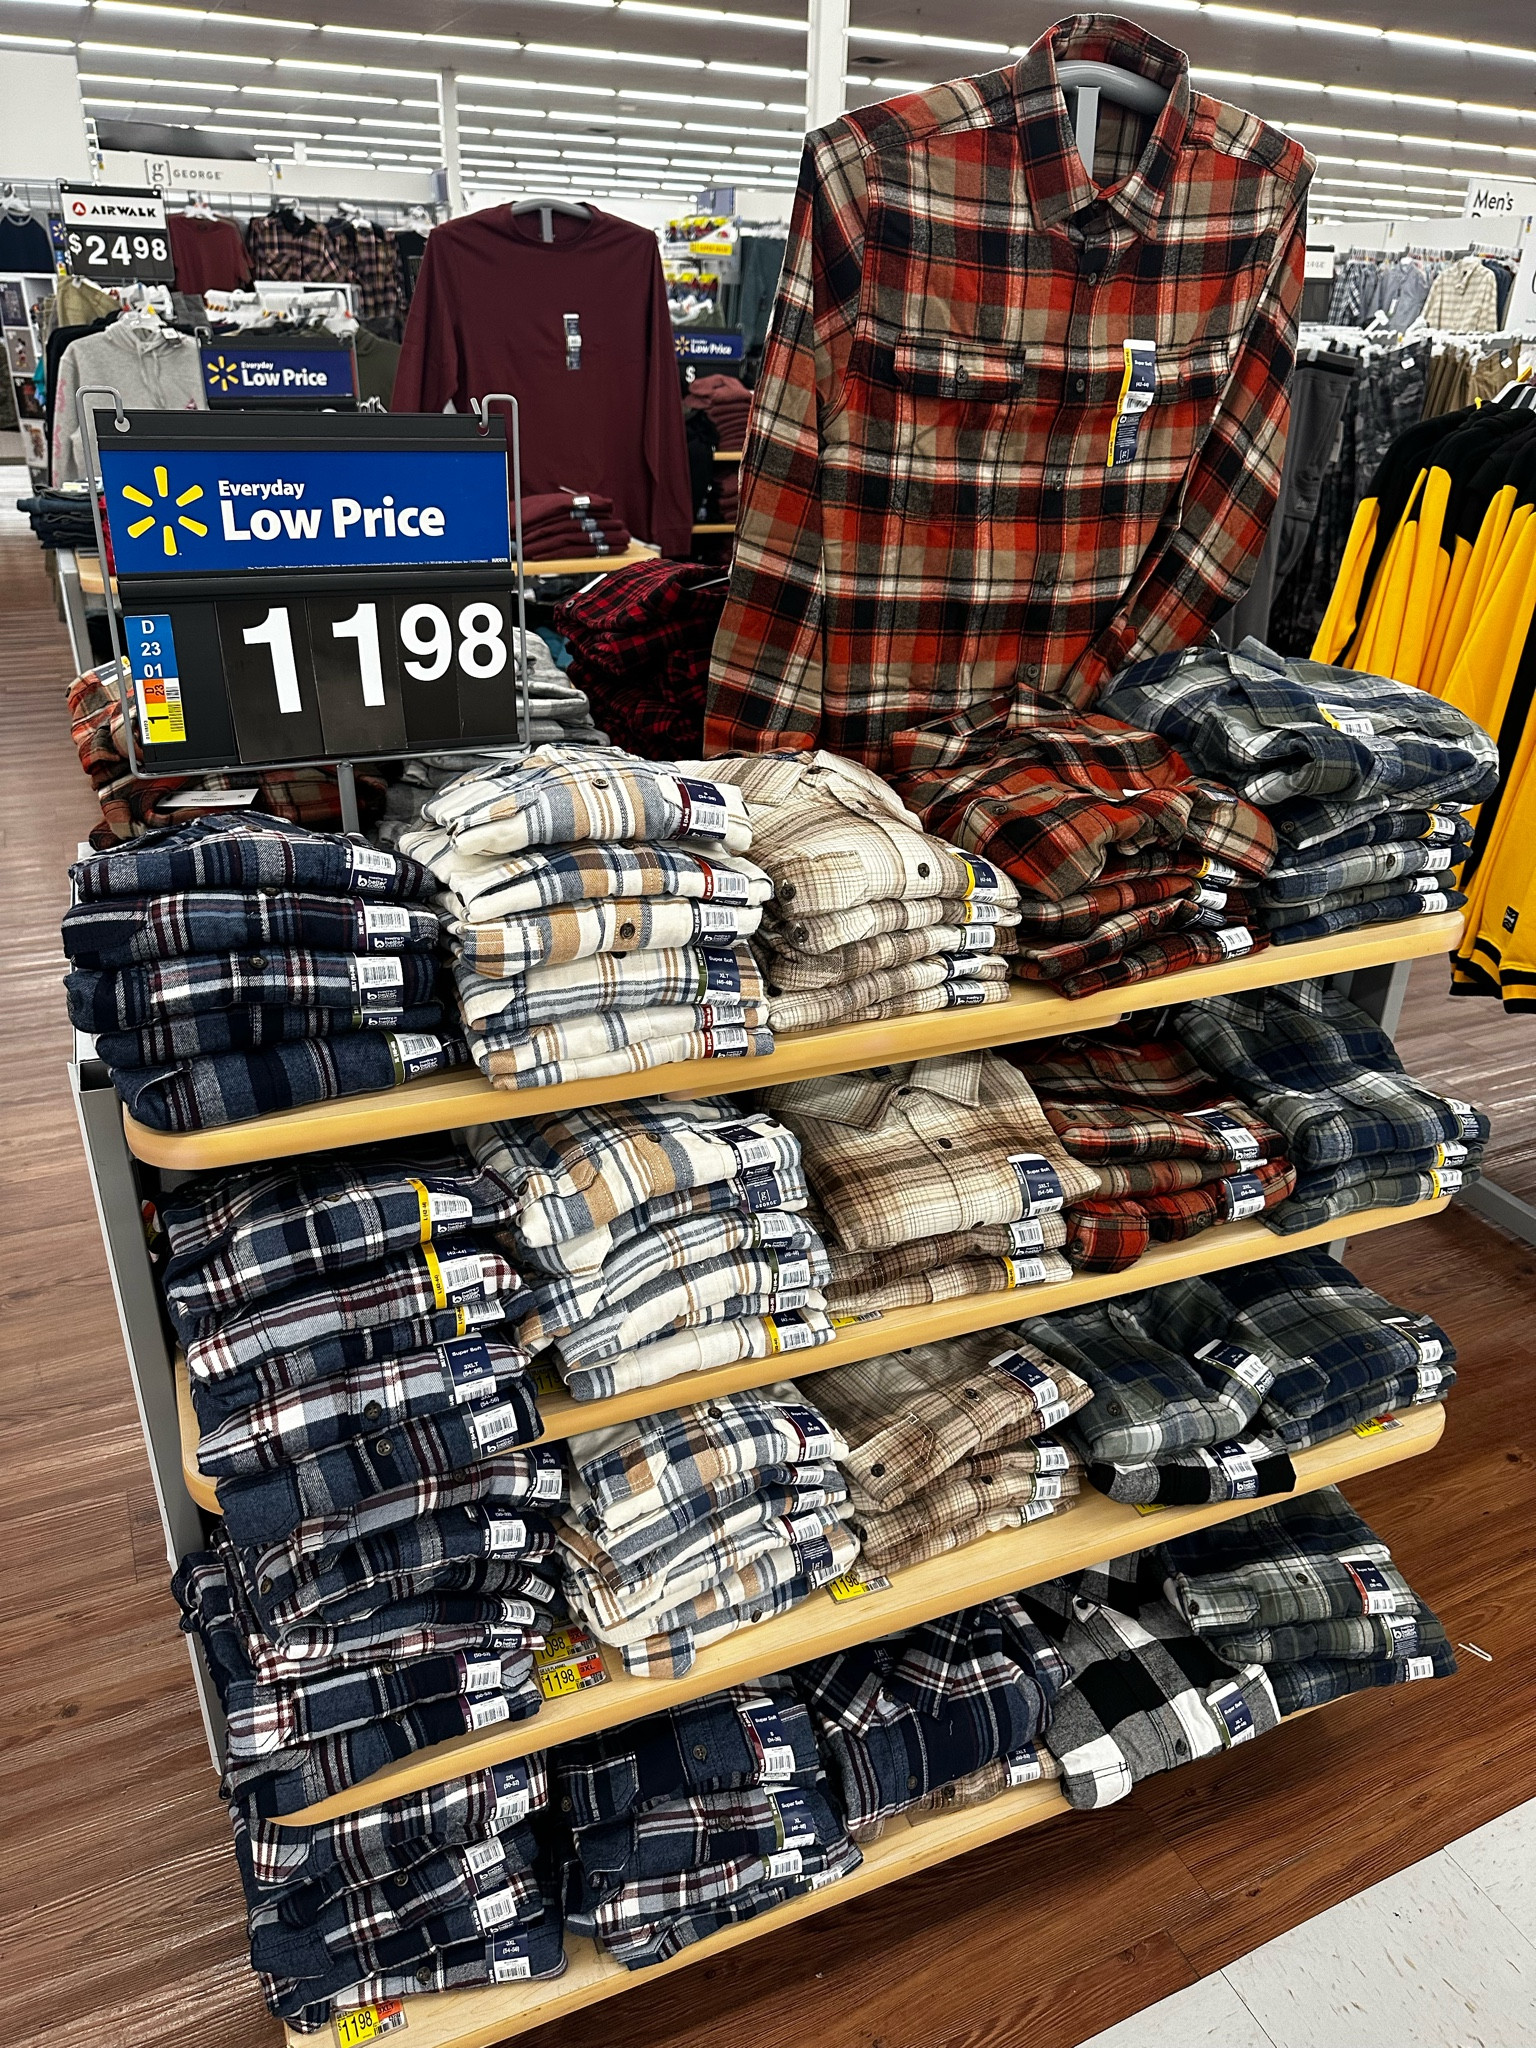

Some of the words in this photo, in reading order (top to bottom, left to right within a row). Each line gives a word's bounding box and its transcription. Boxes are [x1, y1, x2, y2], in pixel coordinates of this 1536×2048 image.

[173, 169, 220, 180] GEORGE
[1473, 190, 1514, 211] Men's
[91, 205, 157, 217] AIRWALK
[709, 344, 732, 356] Price
[240, 361, 274, 371] Everyday
[241, 369, 280, 386] Low
[282, 368, 328, 386] Price
[218, 478, 305, 499] Everyday
[220, 499, 322, 542] Low
[331, 495, 446, 538] Price
[142, 620, 155, 634] D
[140, 642, 162, 656] 23
[144, 664, 163, 678] 01
[708, 956, 723, 964] Super
[452, 1348, 470, 1357] Super
[378, 2003, 394, 2014] 3XLT
